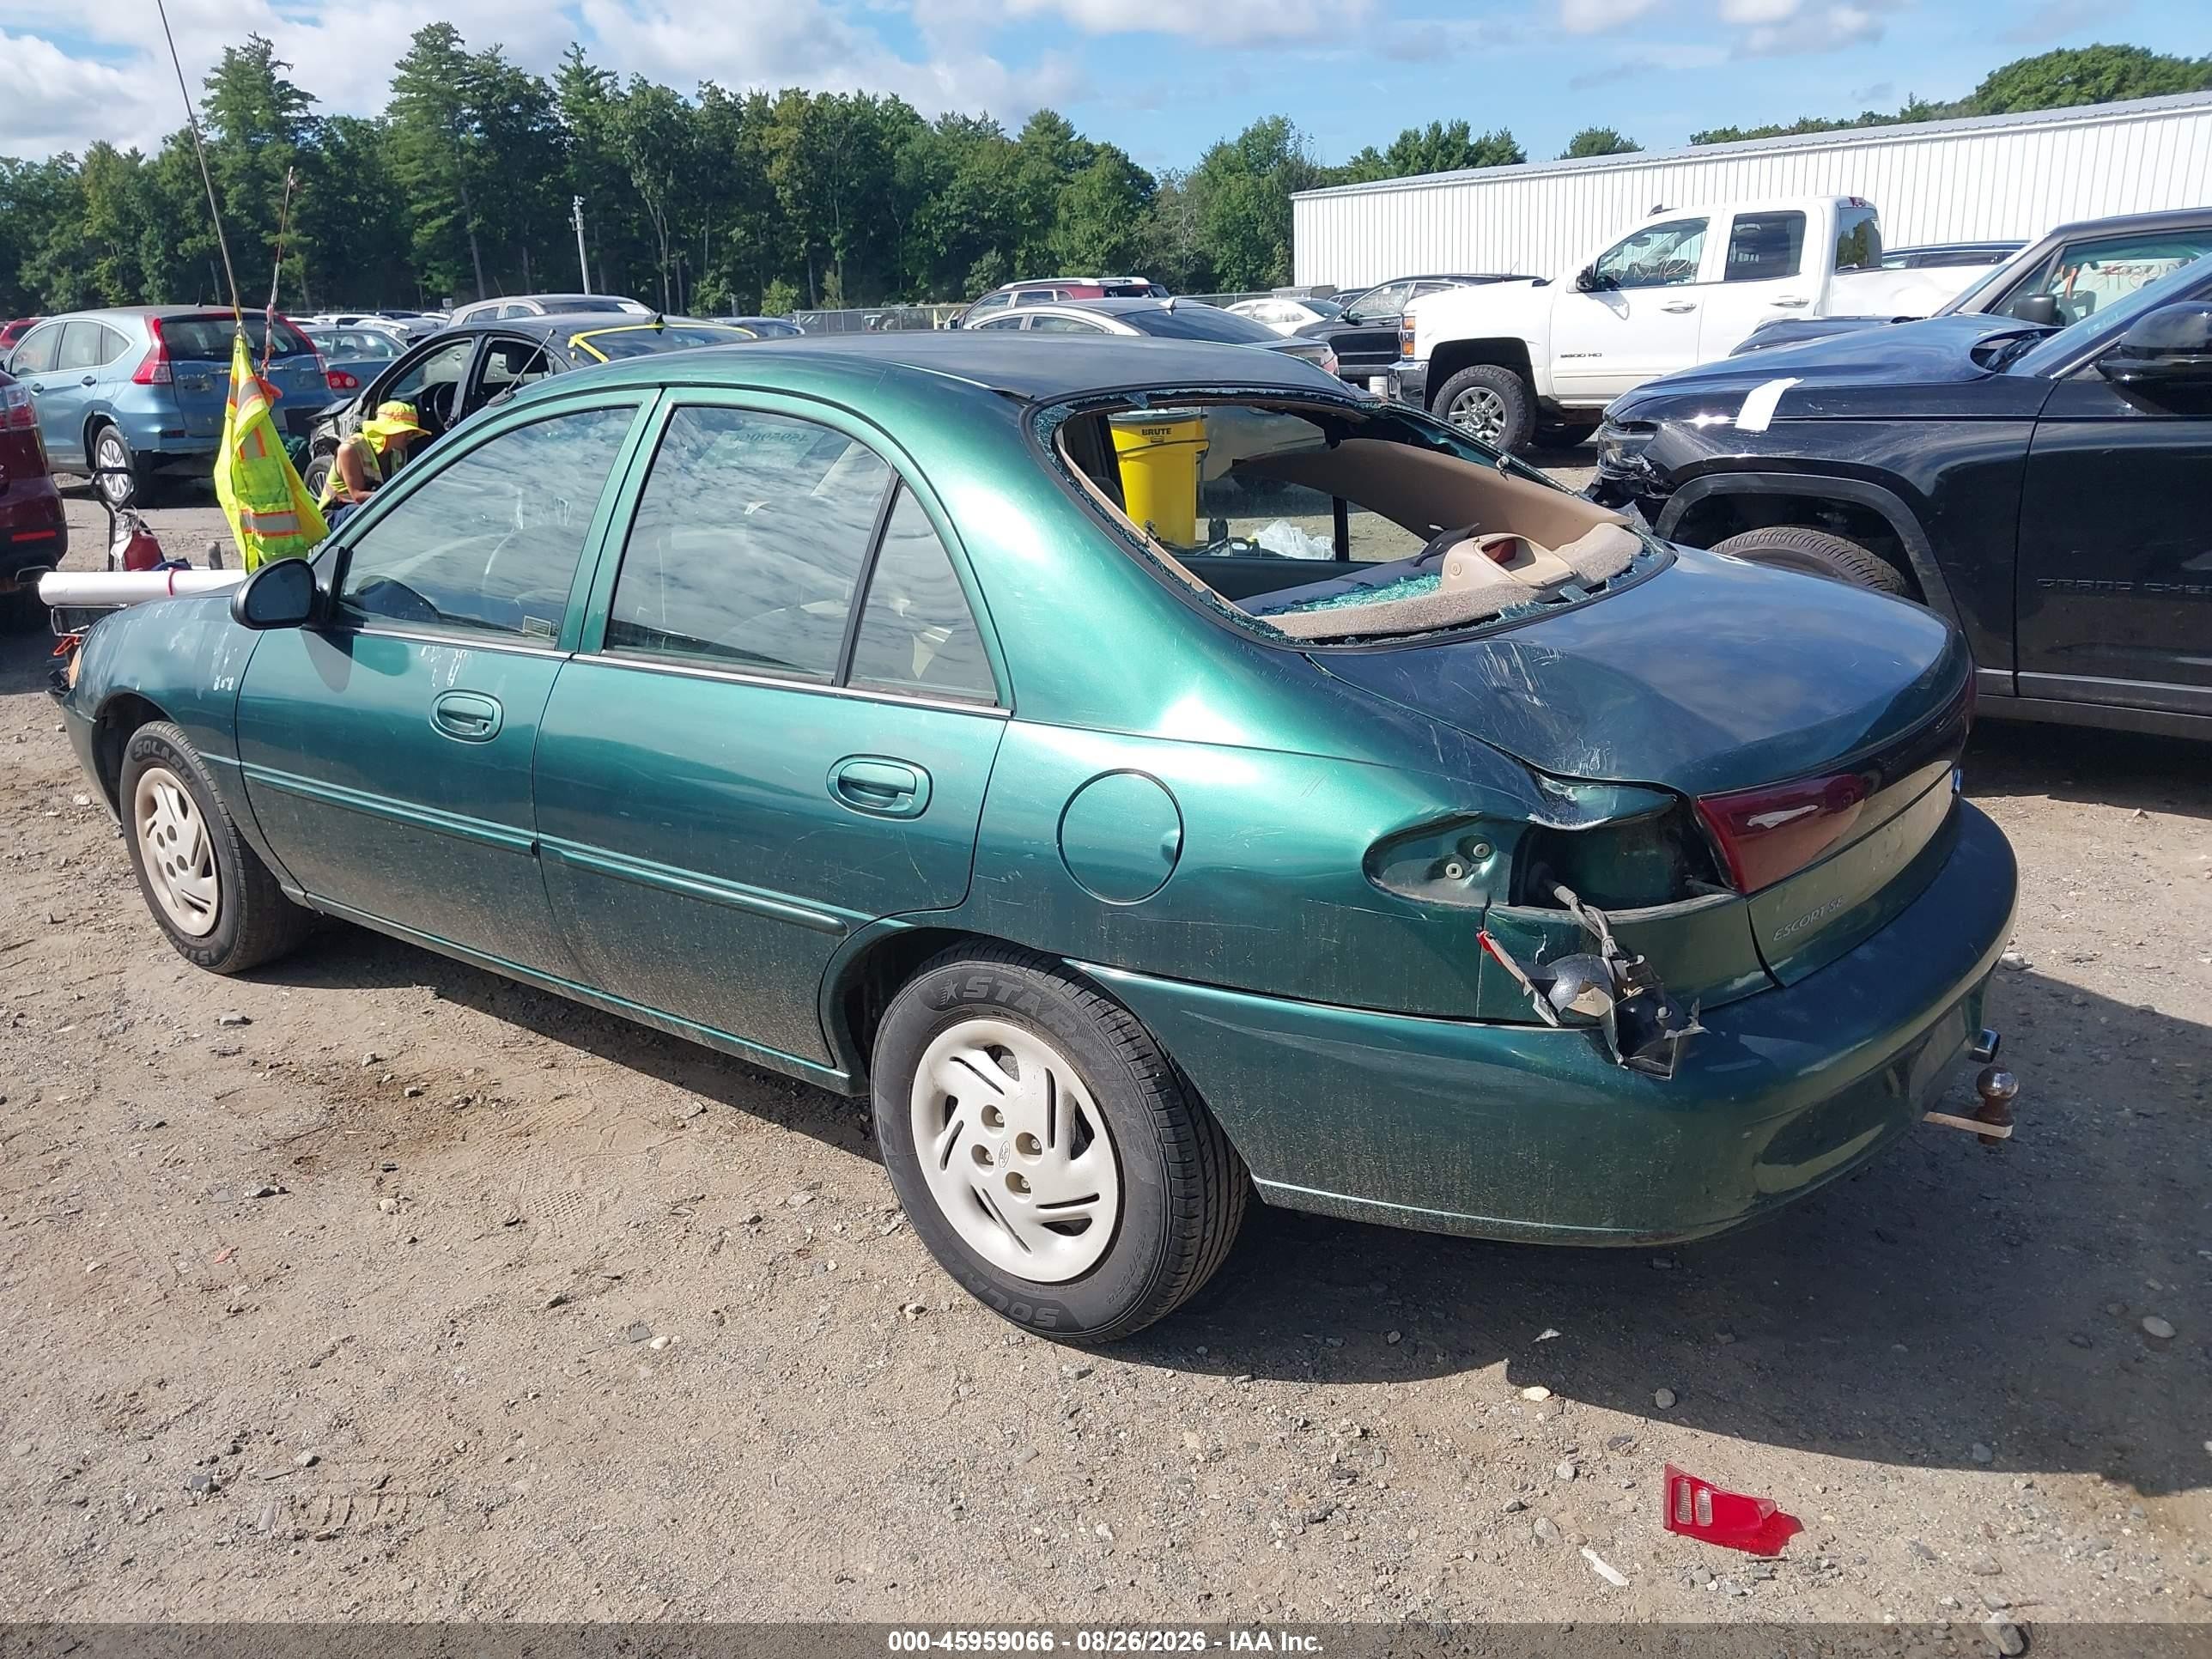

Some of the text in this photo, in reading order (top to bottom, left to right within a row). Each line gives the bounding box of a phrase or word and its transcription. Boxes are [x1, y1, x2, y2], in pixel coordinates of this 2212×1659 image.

[1141, 428, 1172, 436] BRUTE
[1772, 896, 1844, 942] ESCORT SE
